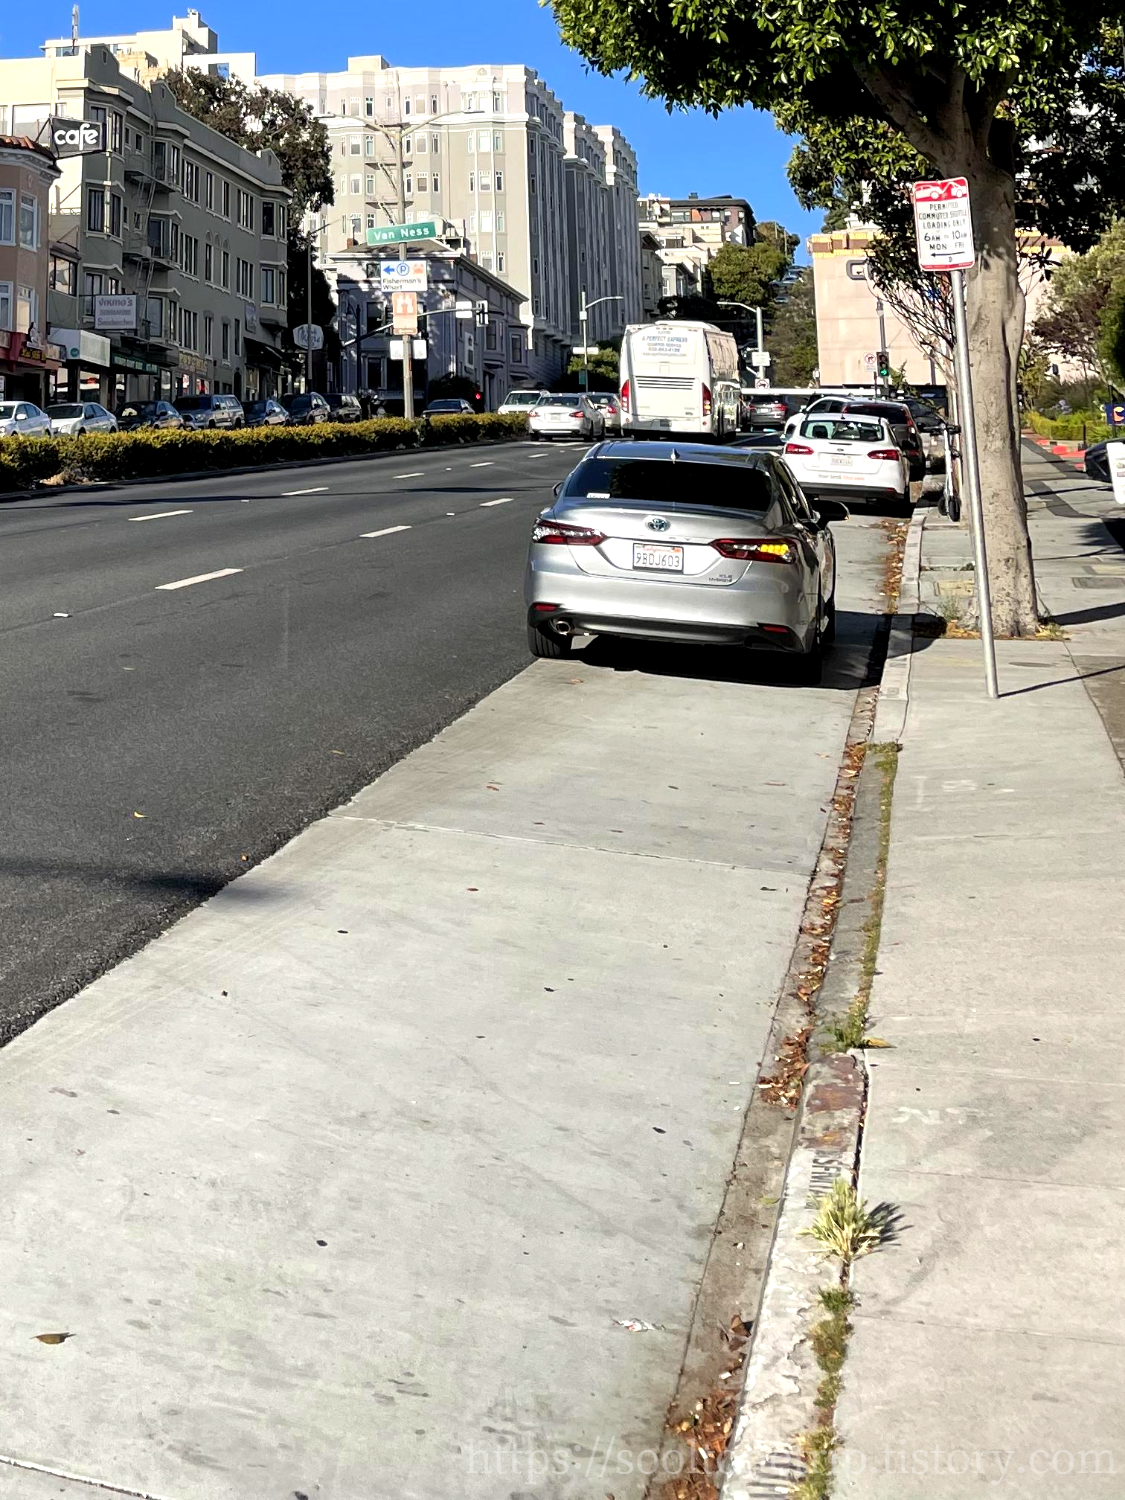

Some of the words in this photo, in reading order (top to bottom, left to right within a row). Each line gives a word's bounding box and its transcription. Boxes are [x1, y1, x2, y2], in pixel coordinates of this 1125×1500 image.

[54, 123, 99, 151] cafe
[918, 211, 949, 221] COMMUTER
[923, 221, 951, 230] LOADING
[374, 231, 395, 240] Van
[400, 227, 430, 238] Ness
[929, 243, 948, 251] MON
